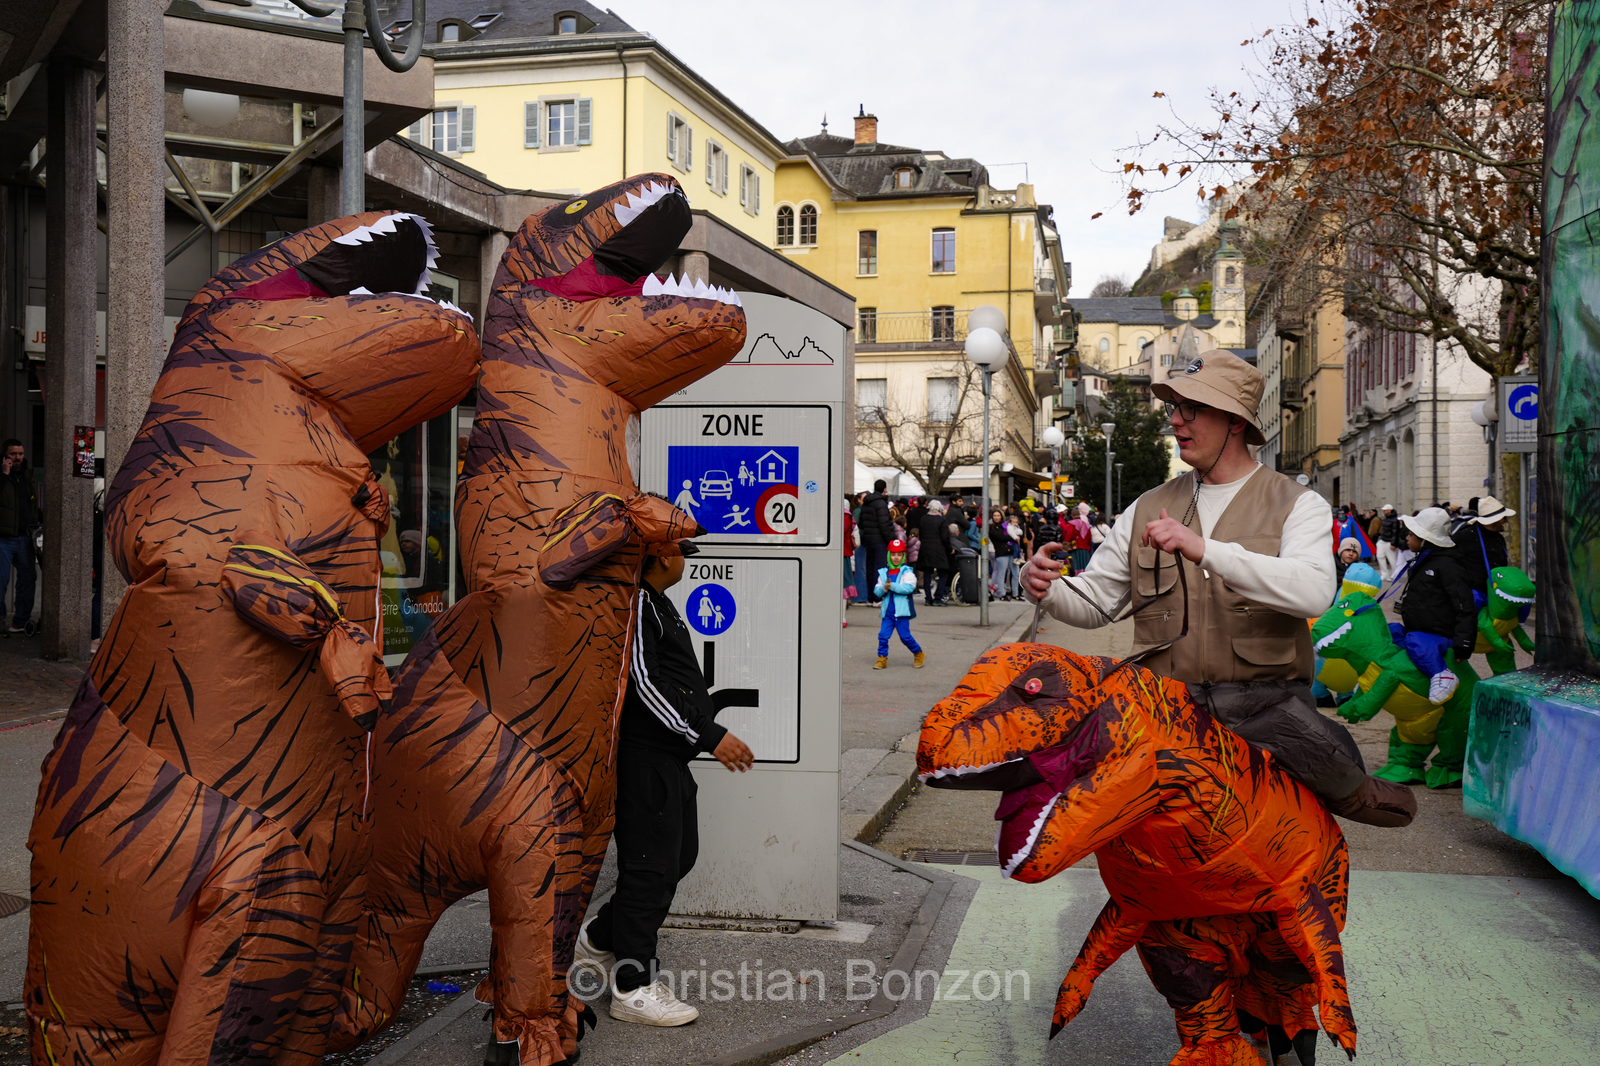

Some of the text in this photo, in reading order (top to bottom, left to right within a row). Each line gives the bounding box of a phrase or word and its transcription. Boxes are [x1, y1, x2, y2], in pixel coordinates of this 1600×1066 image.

[32, 331, 46, 344] JE
[701, 414, 764, 437] ZONE
[771, 502, 796, 524] 20
[689, 564, 734, 580] ZONE
[383, 596, 443, 616] erre Gianadda
